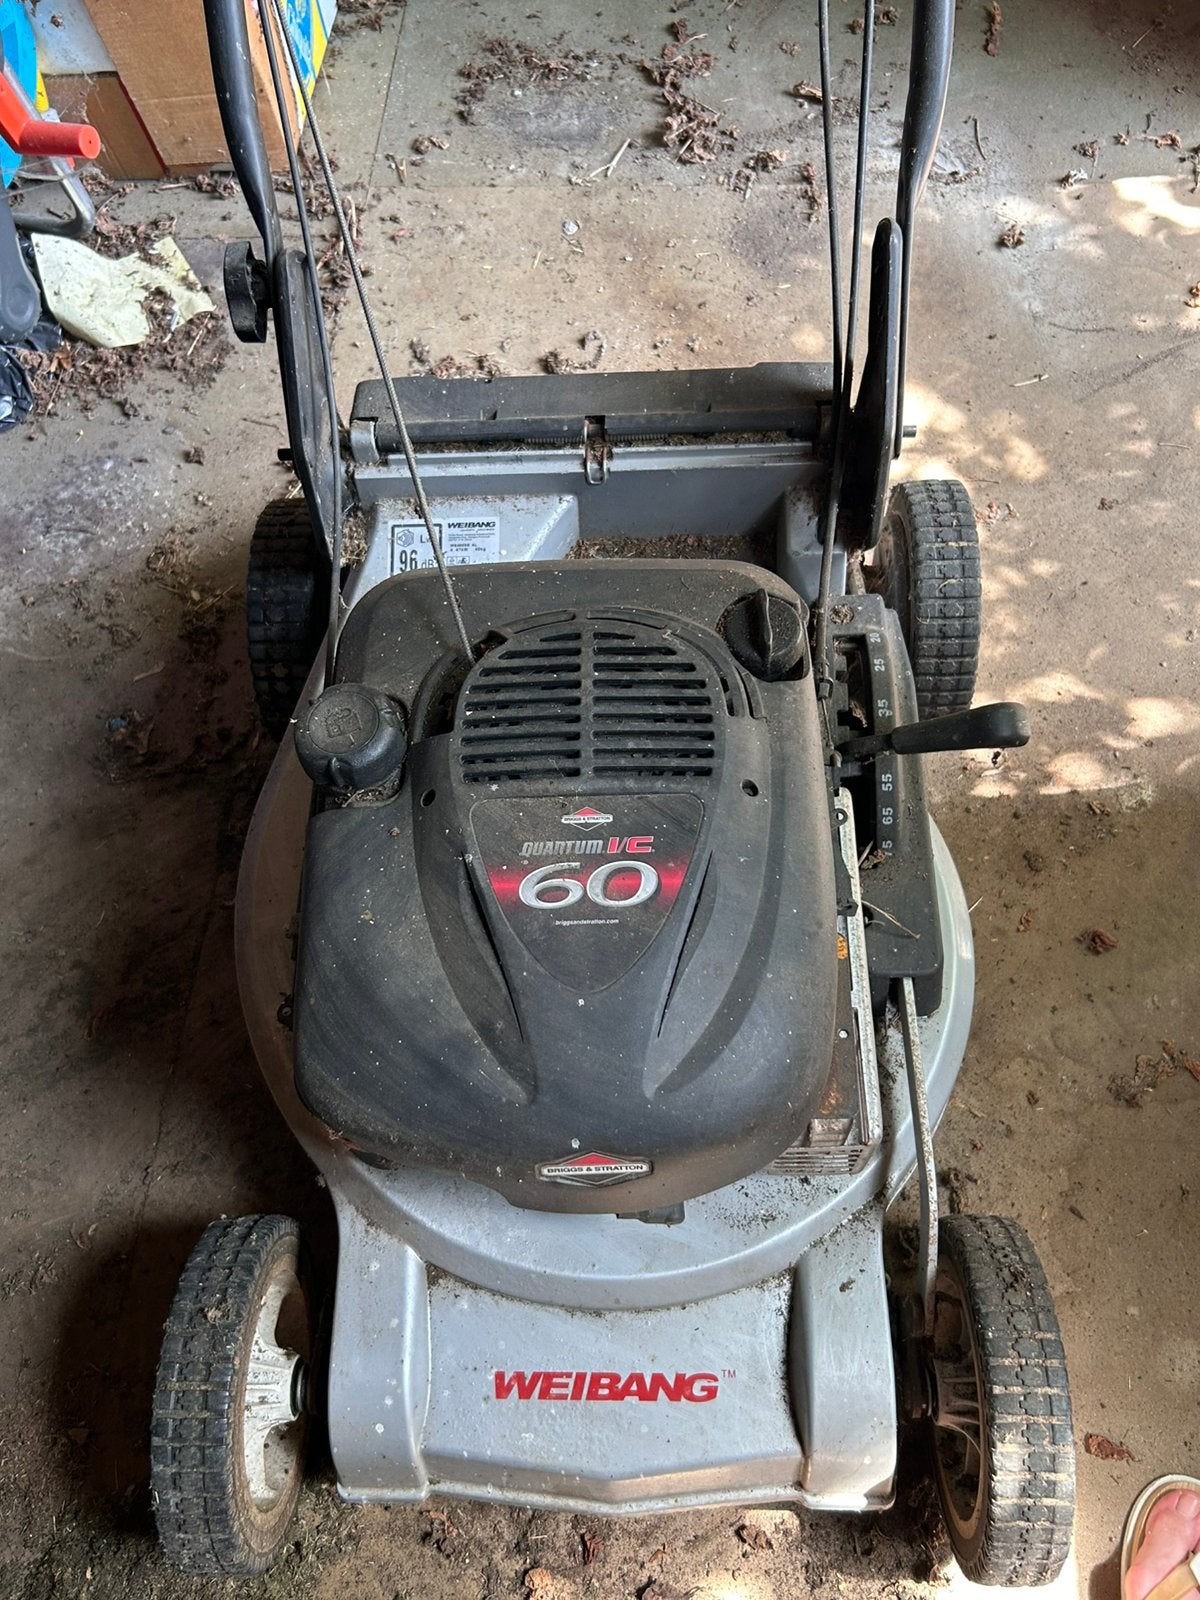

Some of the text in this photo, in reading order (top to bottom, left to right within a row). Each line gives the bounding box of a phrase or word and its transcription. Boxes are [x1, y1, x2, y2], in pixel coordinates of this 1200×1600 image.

[447, 521, 496, 529] WEIBANG
[400, 549, 418, 572] 96
[869, 632, 881, 643] 20
[873, 658, 885, 672] 25
[877, 699, 889, 717] 35
[881, 773, 893, 791] 55
[882, 807, 894, 825] 65
[519, 839, 604, 857] QUANTUM
[518, 860, 659, 909] 60
[494, 1371, 719, 1403] WEIBANG
